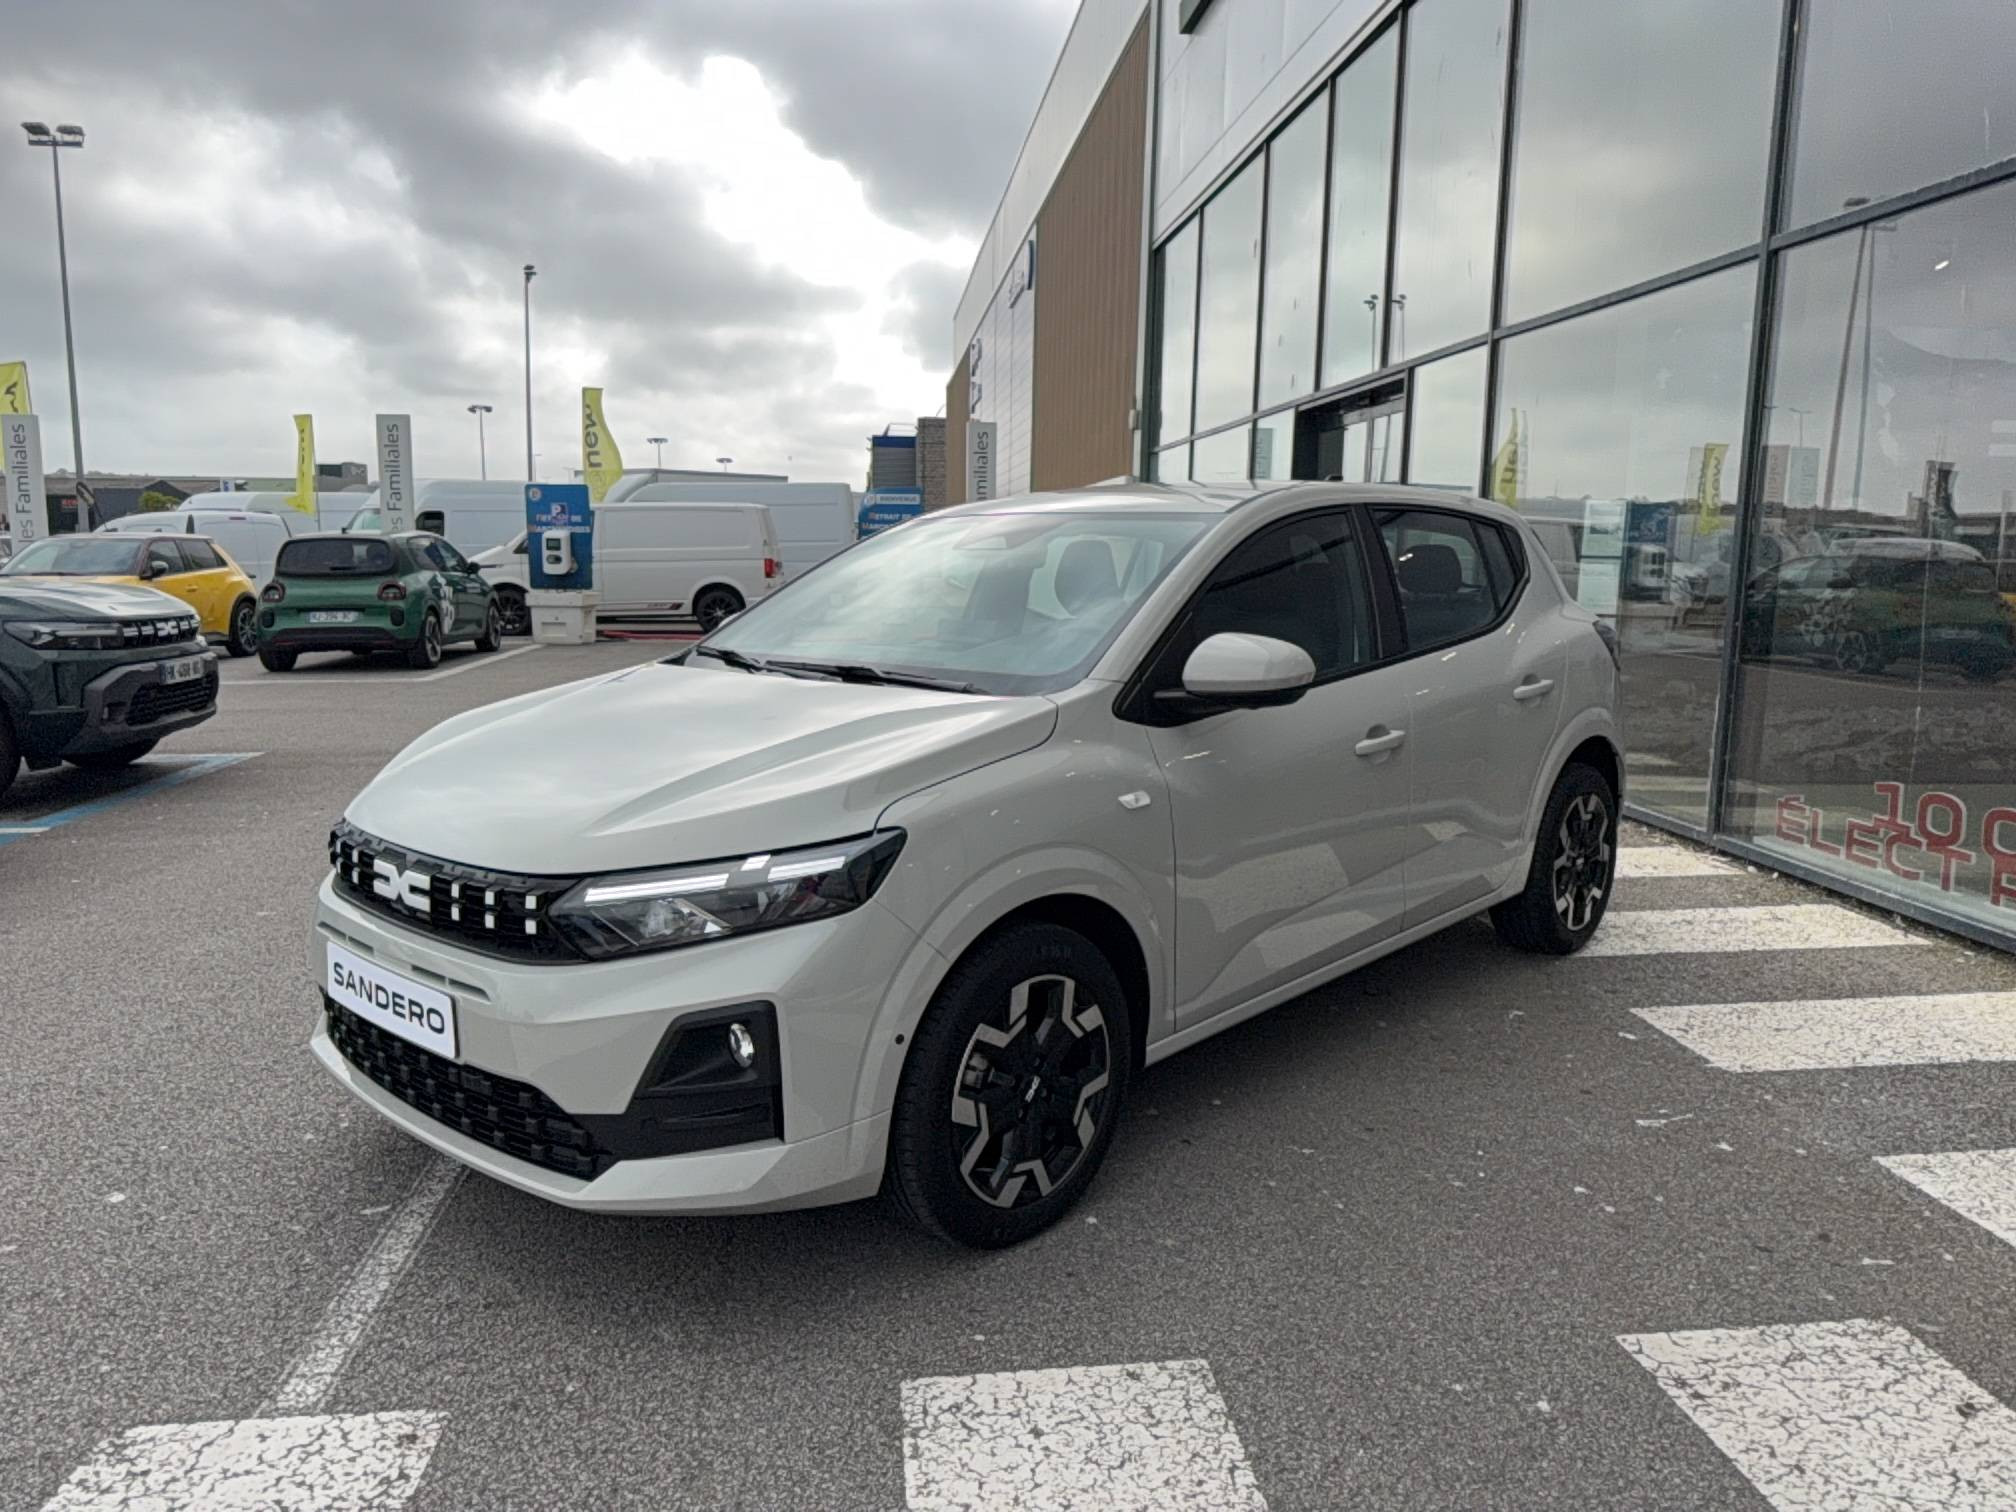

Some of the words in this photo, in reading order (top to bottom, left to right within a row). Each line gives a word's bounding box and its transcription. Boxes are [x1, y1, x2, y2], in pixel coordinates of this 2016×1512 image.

[10, 423, 32, 514] Familiales
[384, 423, 402, 511] Familiales
[584, 404, 602, 468] new
[333, 961, 446, 1035] SANDERO
